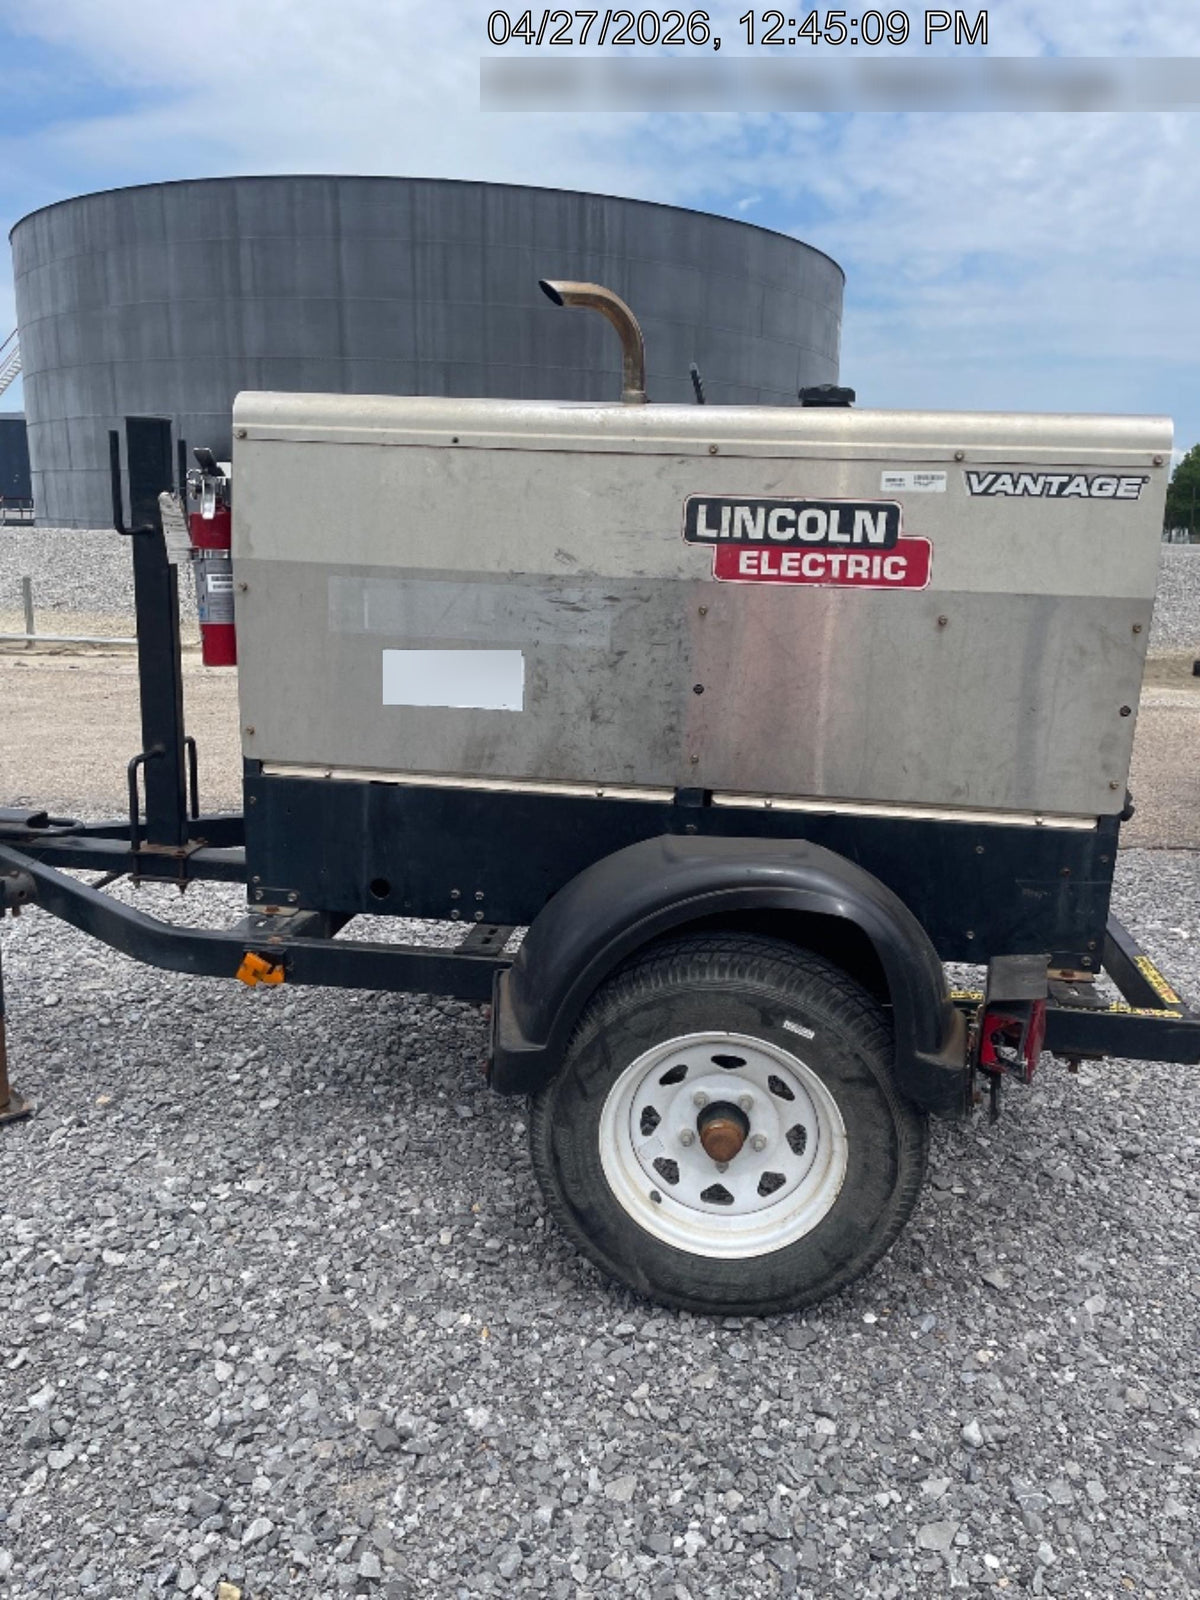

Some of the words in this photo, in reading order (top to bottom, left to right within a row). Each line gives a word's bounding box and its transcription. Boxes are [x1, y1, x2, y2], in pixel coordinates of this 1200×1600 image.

[969, 473, 1143, 498] VANTAGE
[696, 504, 888, 544] LINCOLN
[739, 551, 908, 581] ELECTRIC
